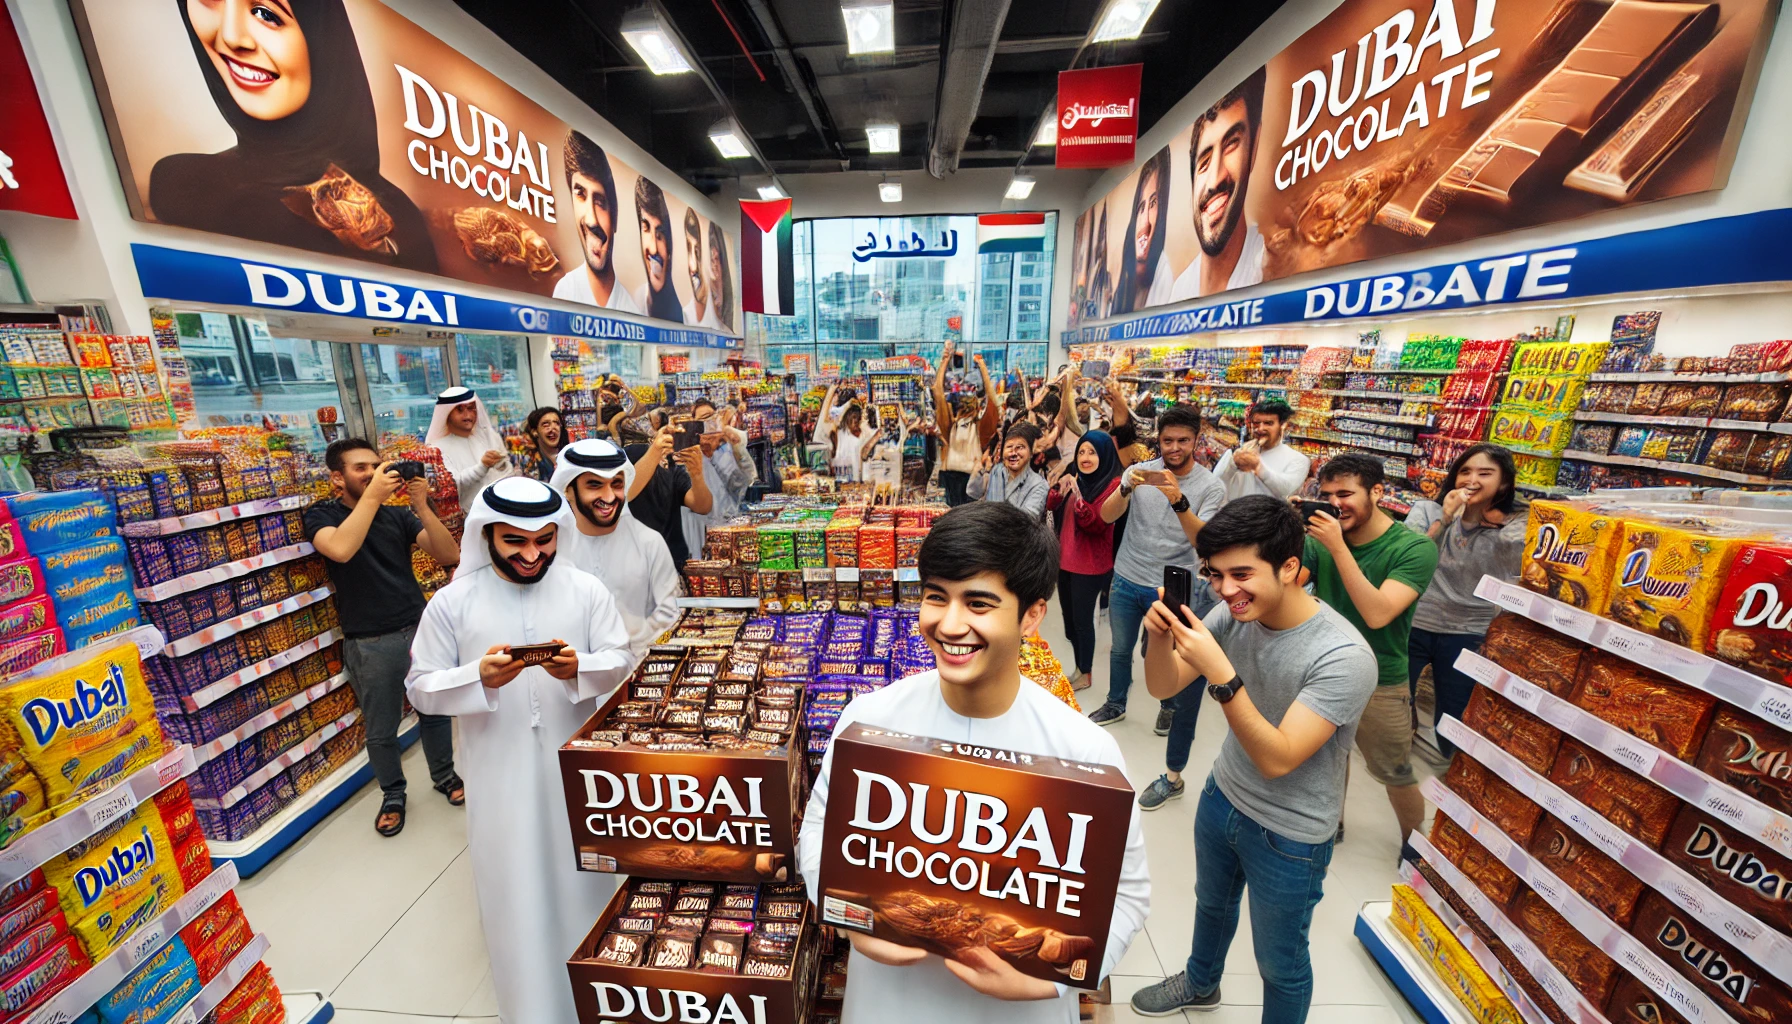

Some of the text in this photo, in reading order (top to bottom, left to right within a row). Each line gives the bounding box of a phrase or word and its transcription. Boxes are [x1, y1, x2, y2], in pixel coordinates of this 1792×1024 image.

[1281, 0, 1497, 147] DUBAI
[394, 63, 552, 191] DUBAI
[1274, 47, 1501, 191] CHOCOLATE
[407, 139, 557, 224] CHOCOLATE
[240, 262, 459, 326] DUBAI
[578, 768, 767, 818] DUBAI
[585, 813, 773, 847] CHOCOLATE
[849, 768, 1093, 875] DUBAI
[841, 834, 1085, 918] CHOCOLATE
[589, 981, 768, 1024] DUBAI
